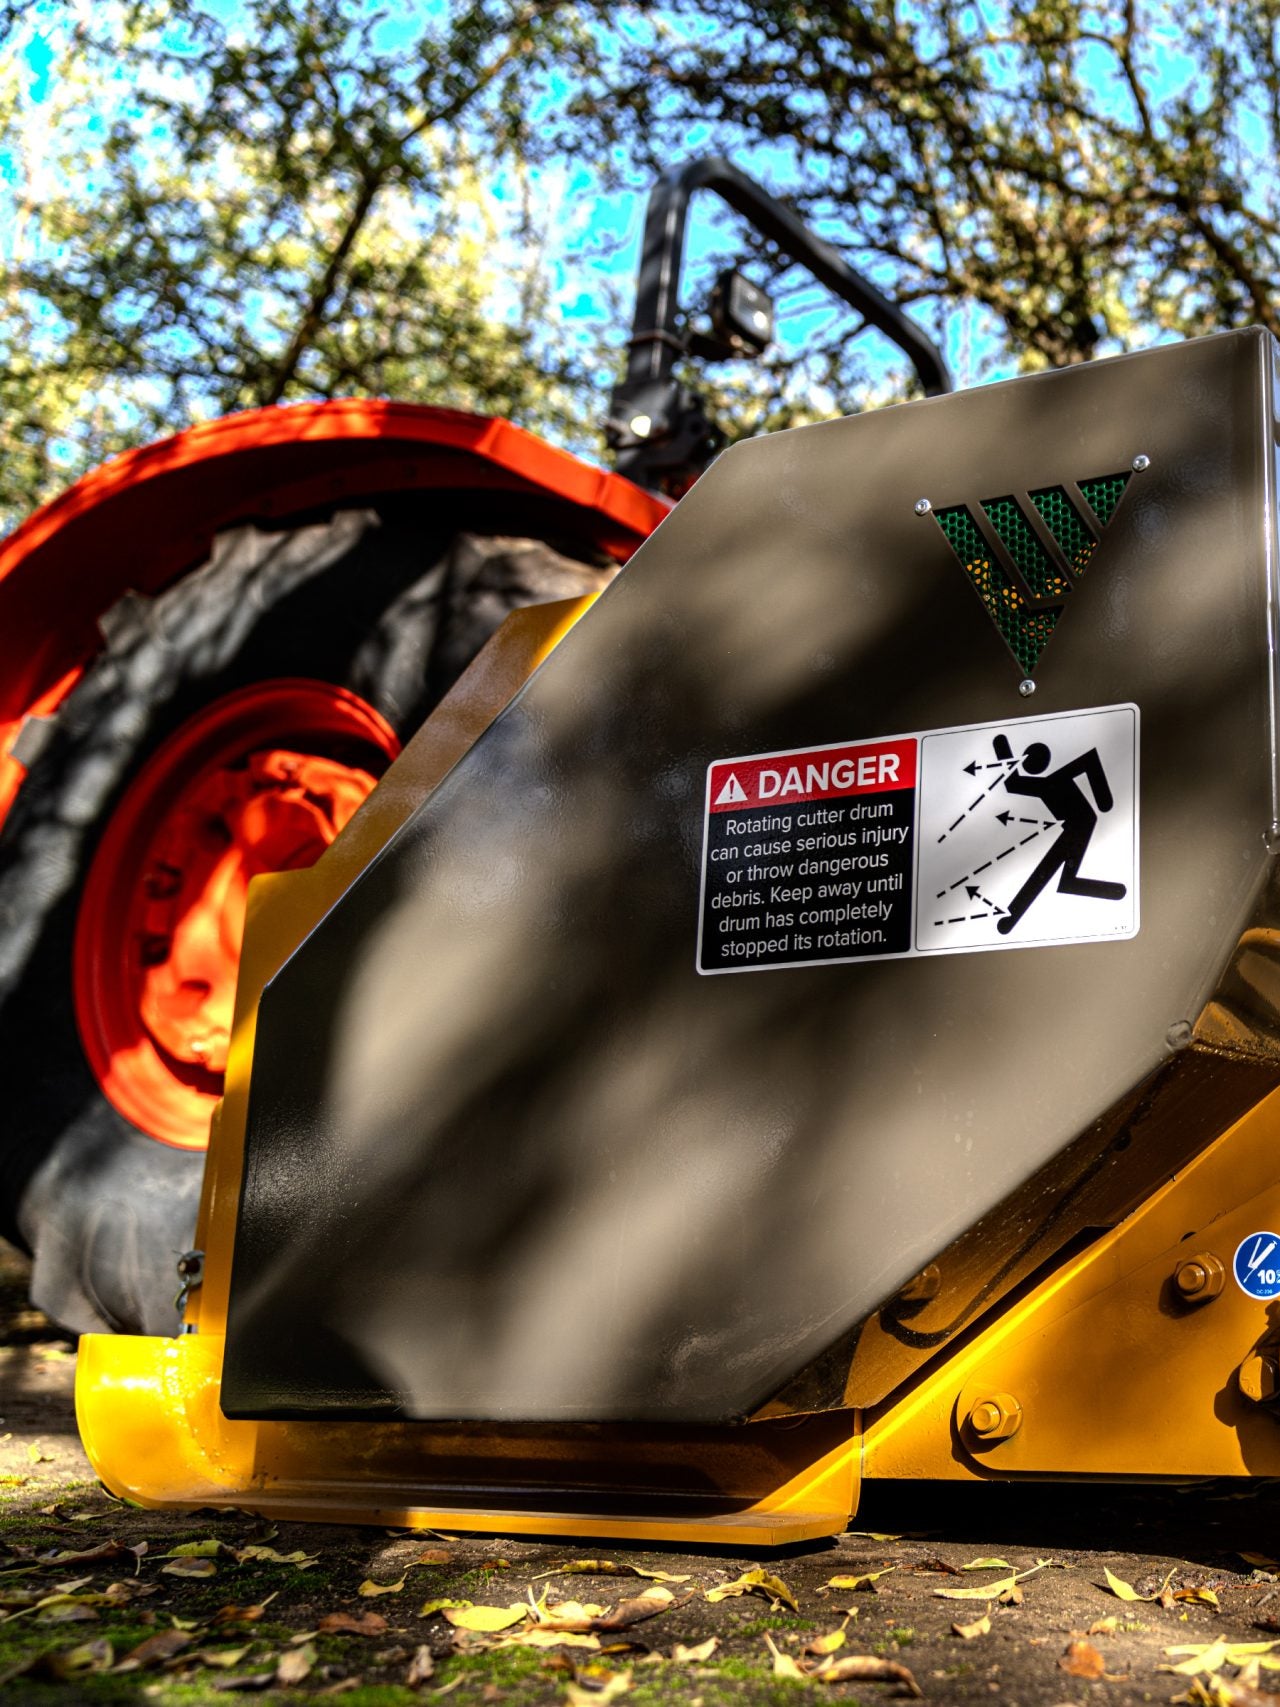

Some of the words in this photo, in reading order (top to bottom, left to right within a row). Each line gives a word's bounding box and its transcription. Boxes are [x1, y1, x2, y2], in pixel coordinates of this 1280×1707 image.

[758, 754, 900, 799] DANGER
[726, 815, 792, 835] Rotating
[797, 809, 845, 827] cutter
[850, 803, 893, 821] drum
[711, 847, 738, 861] can
[744, 840, 791, 858] cause
[796, 833, 857, 851] serious
[862, 826, 909, 846] injury
[726, 870, 743, 883] or
[747, 863, 794, 881] throw
[798, 853, 889, 876] dangerous
[711, 890, 765, 909] debris.
[770, 886, 813, 903] Keep
[818, 881, 862, 898] away
[867, 873, 903, 893] until
[719, 916, 760, 933] drum
[765, 912, 794, 928] has
[799, 900, 893, 925] completely
[721, 935, 789, 958] stopped
[794, 934, 812, 950] its
[818, 928, 887, 948] rotation.
[1257, 1269, 1276, 1285] 10
